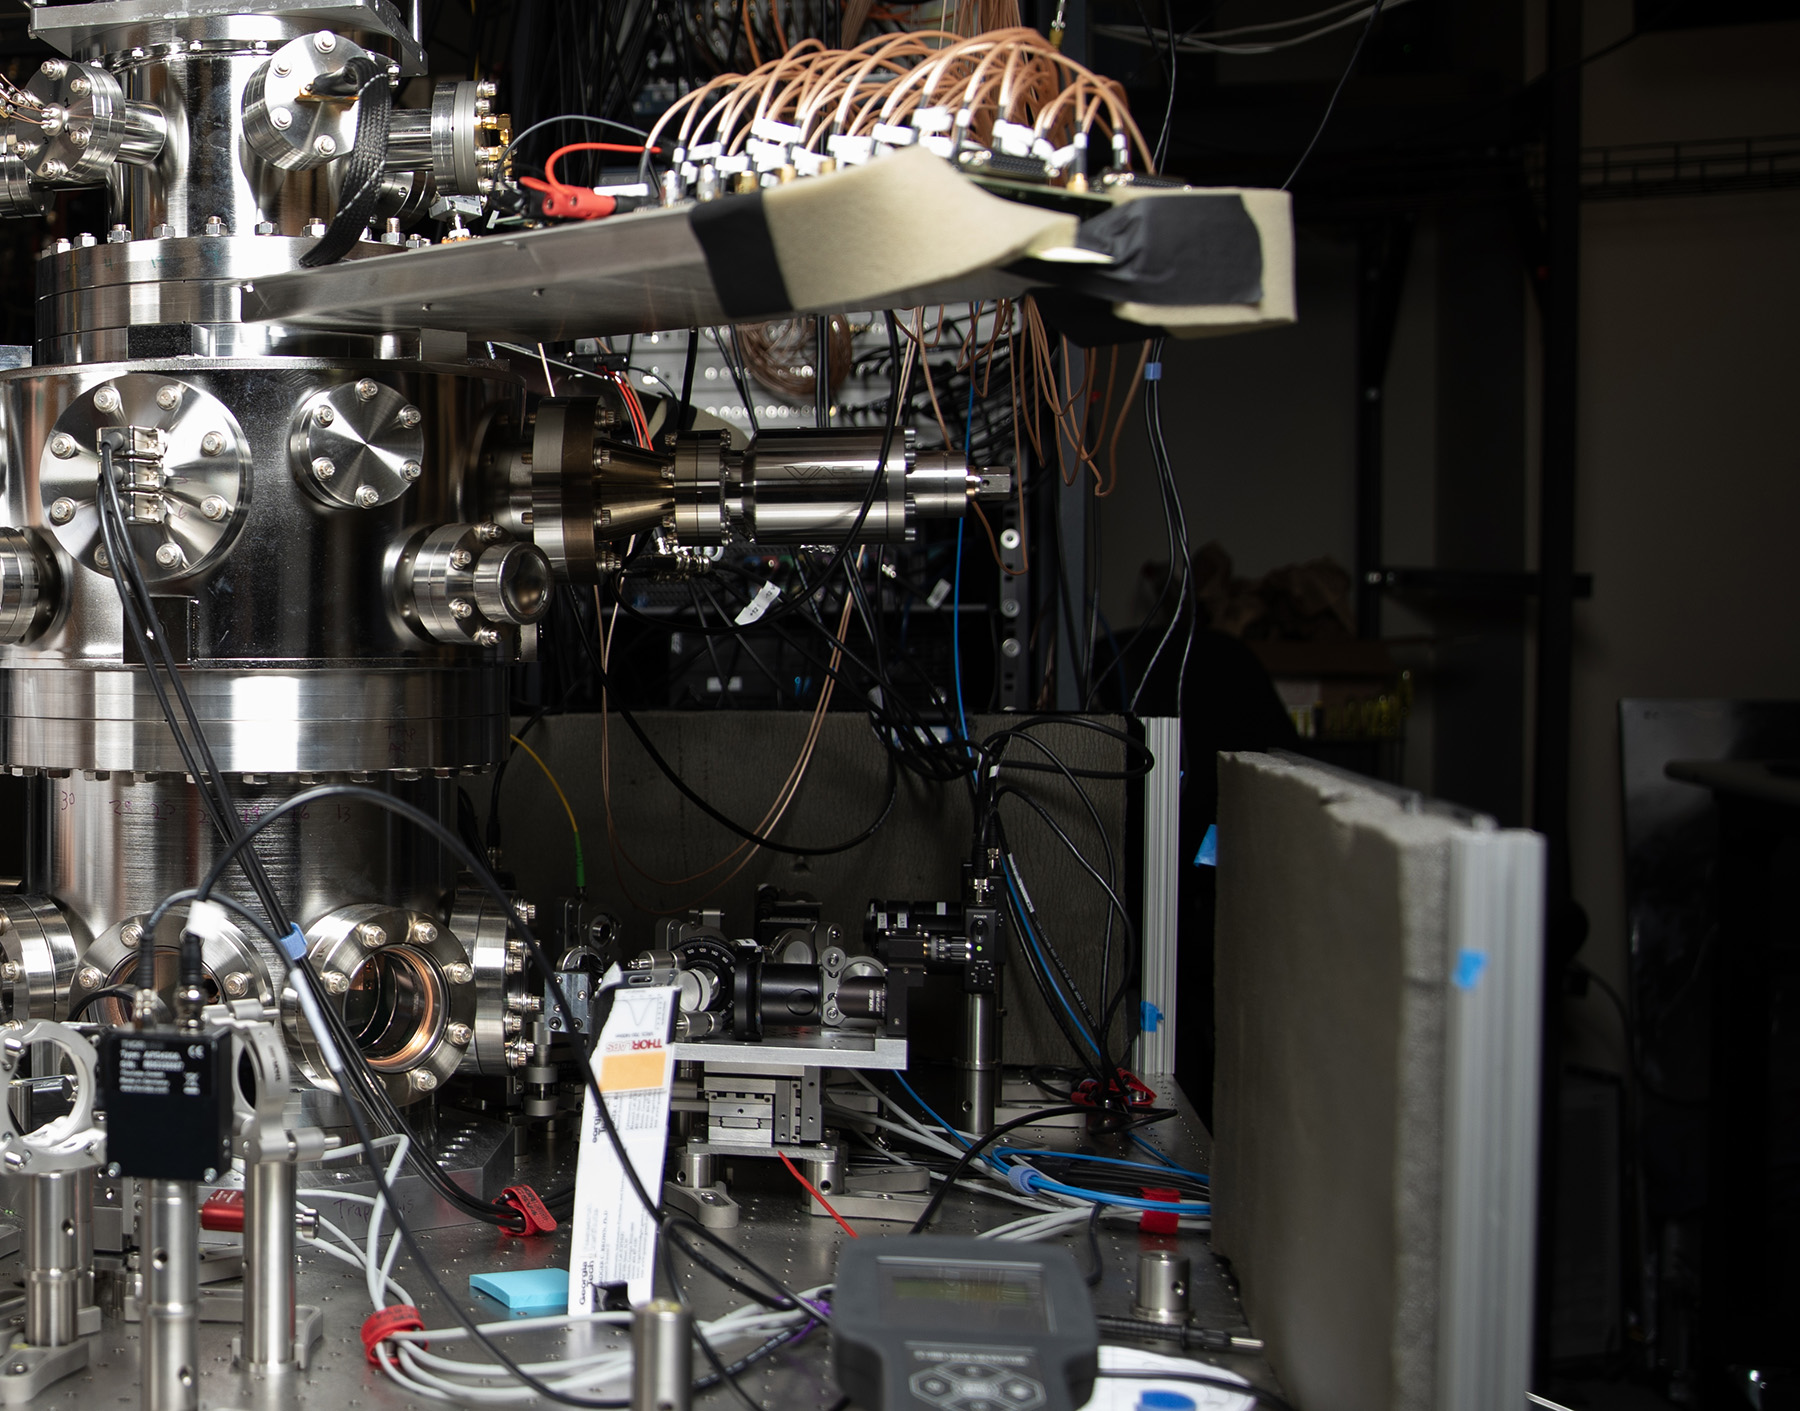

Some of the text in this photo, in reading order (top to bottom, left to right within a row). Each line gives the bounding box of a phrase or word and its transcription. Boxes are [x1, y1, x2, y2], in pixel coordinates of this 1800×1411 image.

[783, 465, 864, 485] VAT
[60, 790, 76, 811] 30
[606, 1038, 663, 1052] THORLABS
[333, 1199, 371, 1224] Trap
[579, 1261, 589, 1306] Georgia
[586, 1260, 595, 1287] Tech
